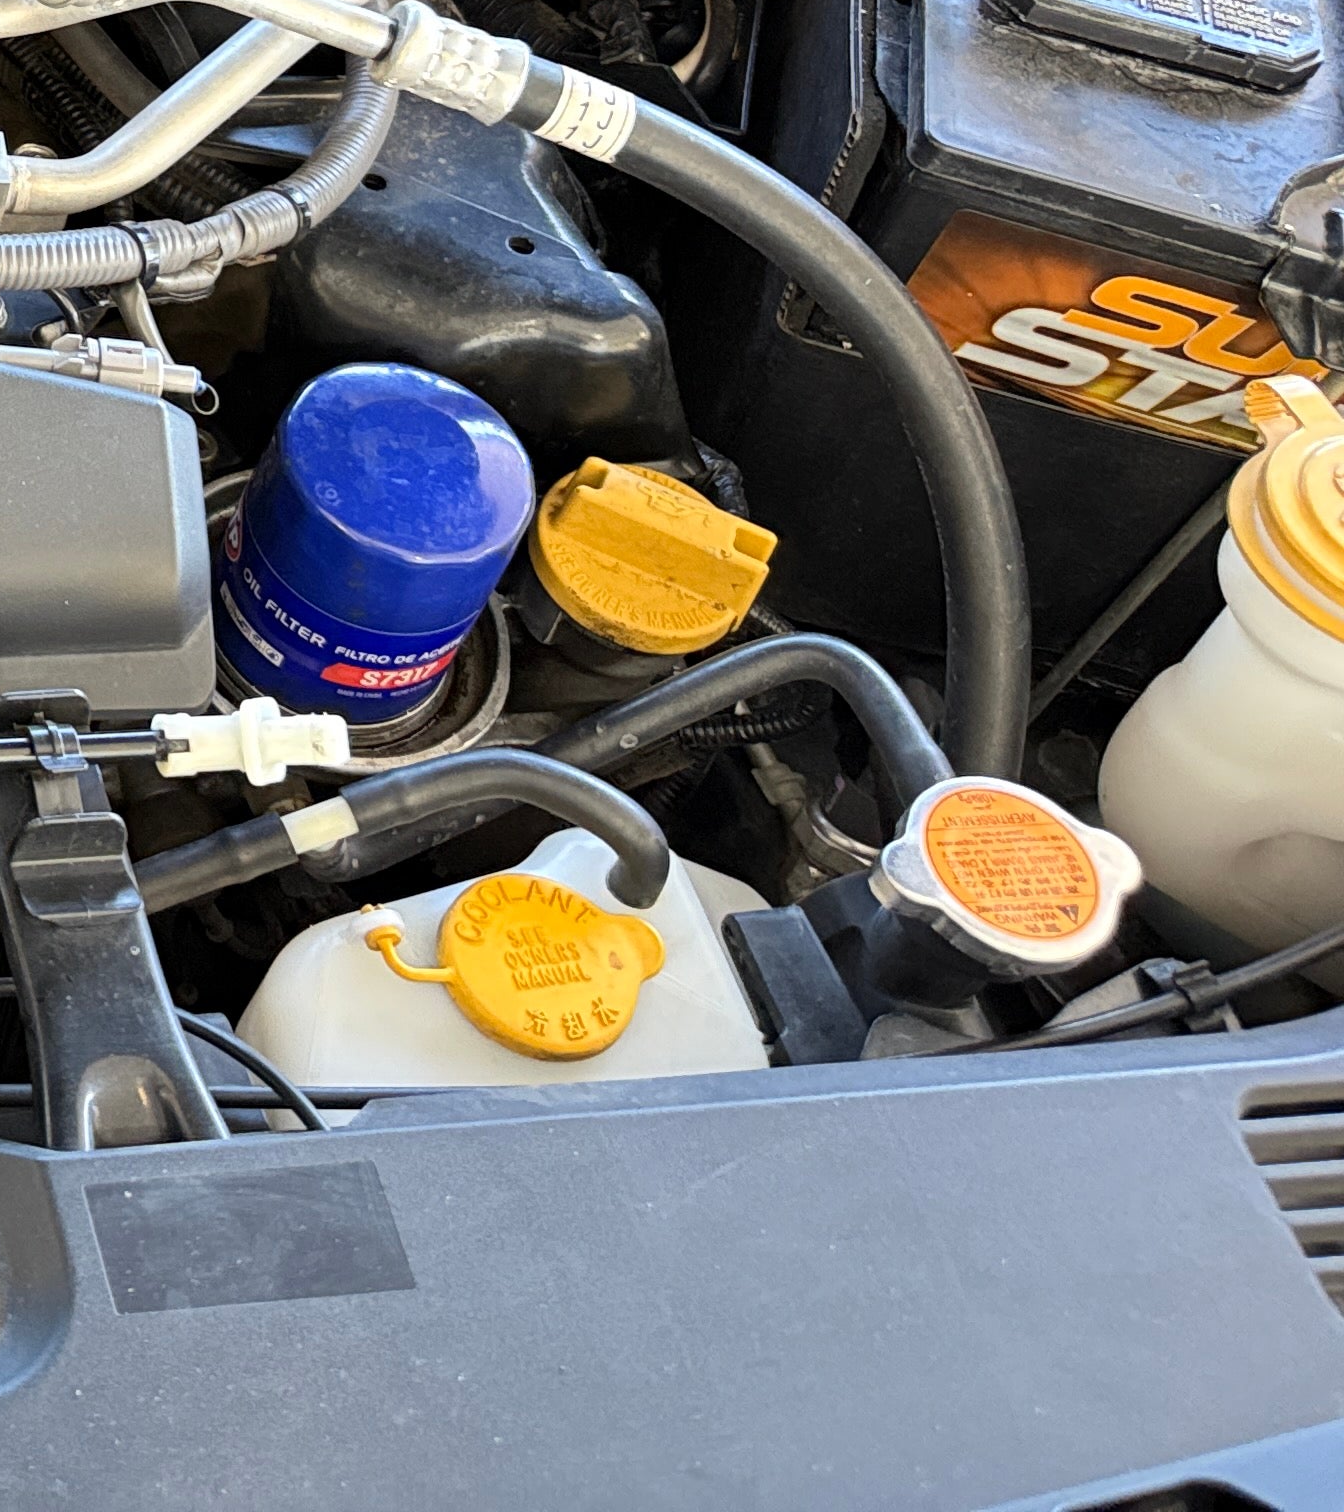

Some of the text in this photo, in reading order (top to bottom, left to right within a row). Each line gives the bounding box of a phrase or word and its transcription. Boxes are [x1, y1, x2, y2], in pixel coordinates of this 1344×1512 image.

[243, 567, 262, 600] OIL
[265, 598, 327, 648] FILTER
[334, 645, 391, 665] FILTRO
[394, 653, 417, 665] DE
[359, 660, 439, 687] S7317
[976, 867, 1011, 878] WHEN
[454, 879, 598, 945] COOLANT
[993, 911, 1059, 924] WARNING
[506, 925, 547, 948] SEE
[503, 941, 581, 970] OWNERS
[512, 963, 592, 991] MANUAL
